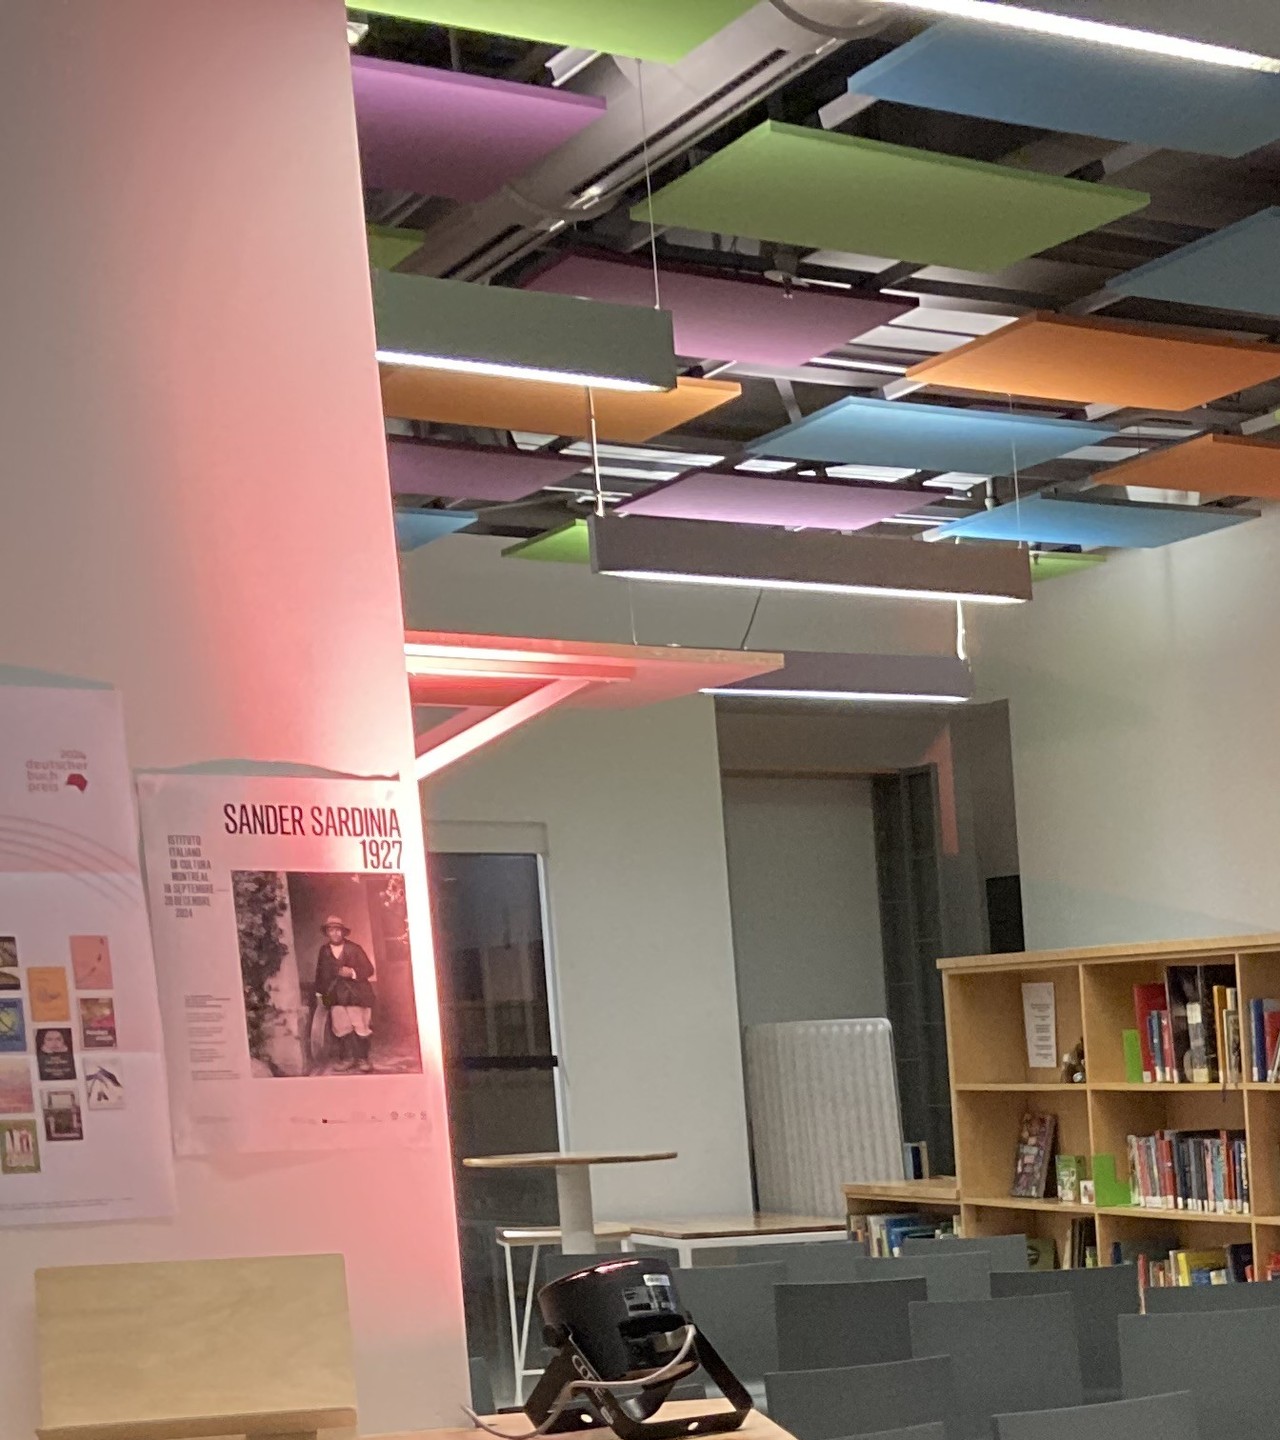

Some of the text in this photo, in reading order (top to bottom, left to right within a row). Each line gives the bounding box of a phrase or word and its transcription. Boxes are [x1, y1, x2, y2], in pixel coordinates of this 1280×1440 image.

[223, 803, 402, 838] SANDER SARDINIA
[359, 839, 403, 870] 1927
